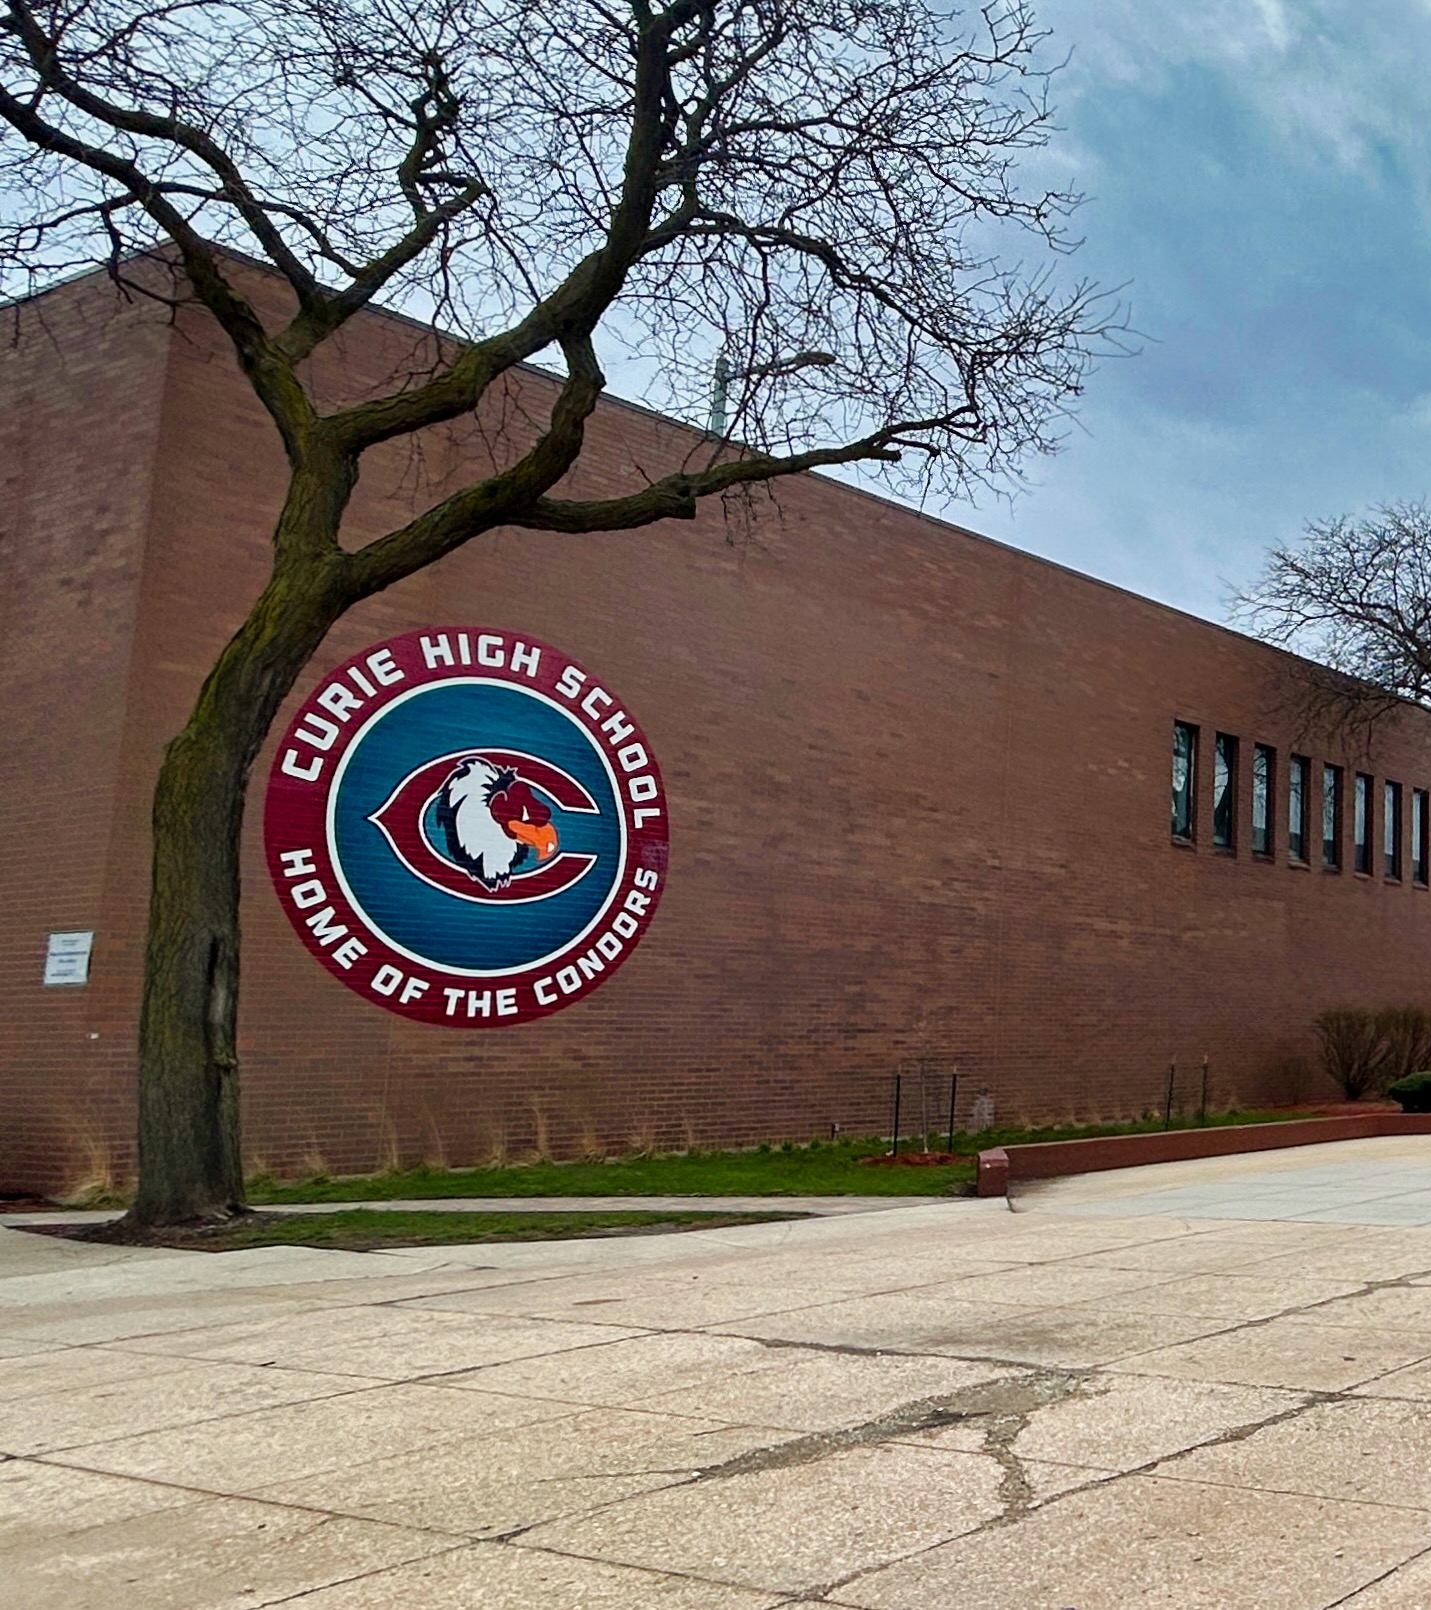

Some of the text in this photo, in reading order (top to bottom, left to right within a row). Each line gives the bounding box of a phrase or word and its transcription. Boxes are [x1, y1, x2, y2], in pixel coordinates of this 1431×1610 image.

[281, 633, 661, 829] CURIE HIGH SCHOOL
[279, 848, 658, 1017] HOME OF THE CONDORS
